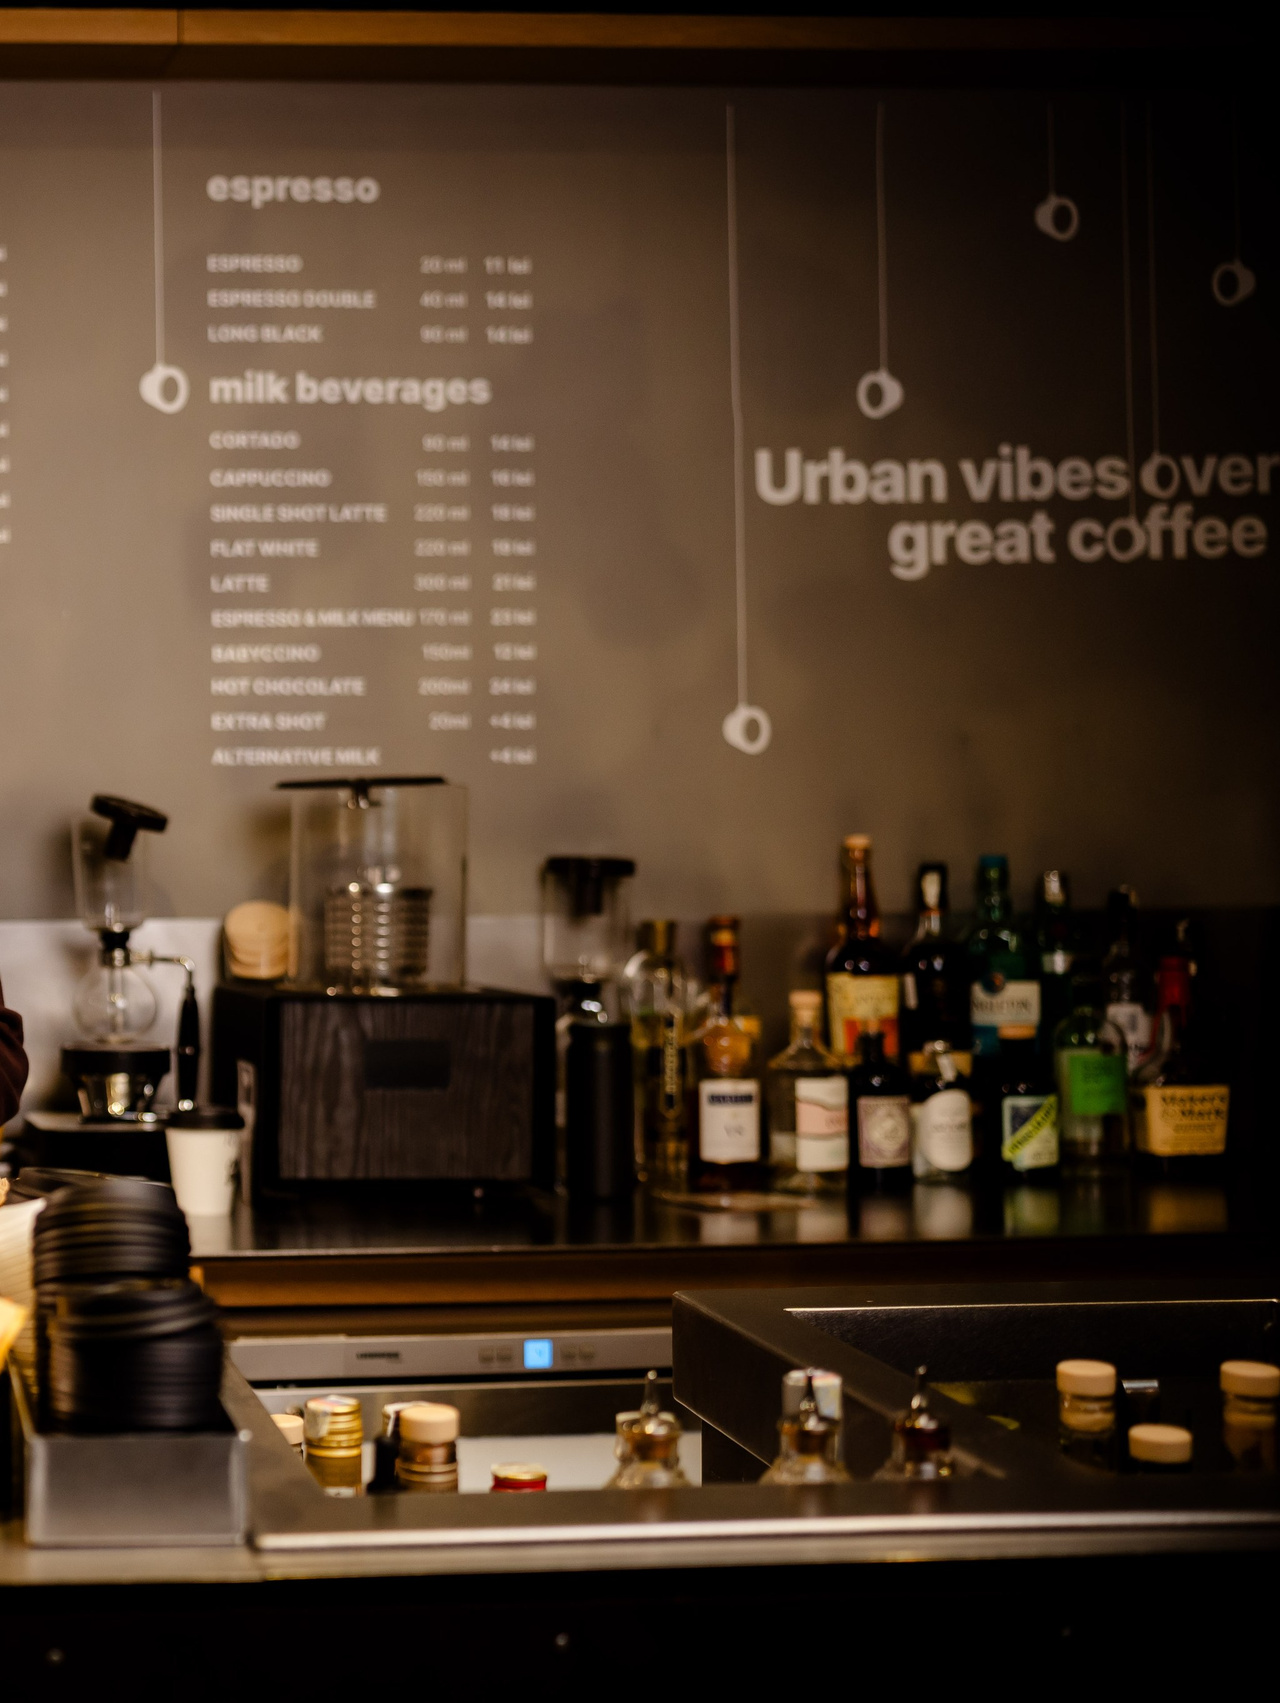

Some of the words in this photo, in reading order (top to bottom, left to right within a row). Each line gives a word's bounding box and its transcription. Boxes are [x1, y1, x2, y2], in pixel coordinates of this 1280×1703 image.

[206, 175, 380, 209] espresso
[207, 254, 303, 273] ESPRESSO
[207, 289, 301, 307] ESPRESSO
[303, 290, 377, 308] DOUBLE
[207, 324, 259, 343] LONG
[261, 324, 323, 343] BLACK
[209, 369, 290, 404] milk
[295, 371, 492, 413] beverages
[208, 431, 300, 451] CORTADO
[208, 468, 333, 488] CAPPUCCINO
[754, 447, 948, 506] Urban
[958, 443, 1132, 502] vibes
[1140, 453, 1280, 500] over
[210, 504, 276, 522] SINGLE
[277, 504, 326, 522] SHOT
[329, 504, 388, 522] LATTE
[210, 539, 256, 557] FLAT
[258, 539, 320, 557] WHITE
[887, 510, 1056, 581] great
[1067, 504, 1268, 563] coffee
[210, 574, 270, 594] LATTE
[211, 609, 303, 627] ESPRESSO
[316, 608, 362, 627] MILK
[360, 608, 415, 627] MENU
[209, 677, 250, 696] HOT
[253, 677, 366, 697] CHOCOLATE
[210, 712, 274, 731] EXTRA
[275, 712, 327, 731] SHOT
[212, 747, 334, 766] ALTERNATIVE
[334, 747, 381, 767] MILK
